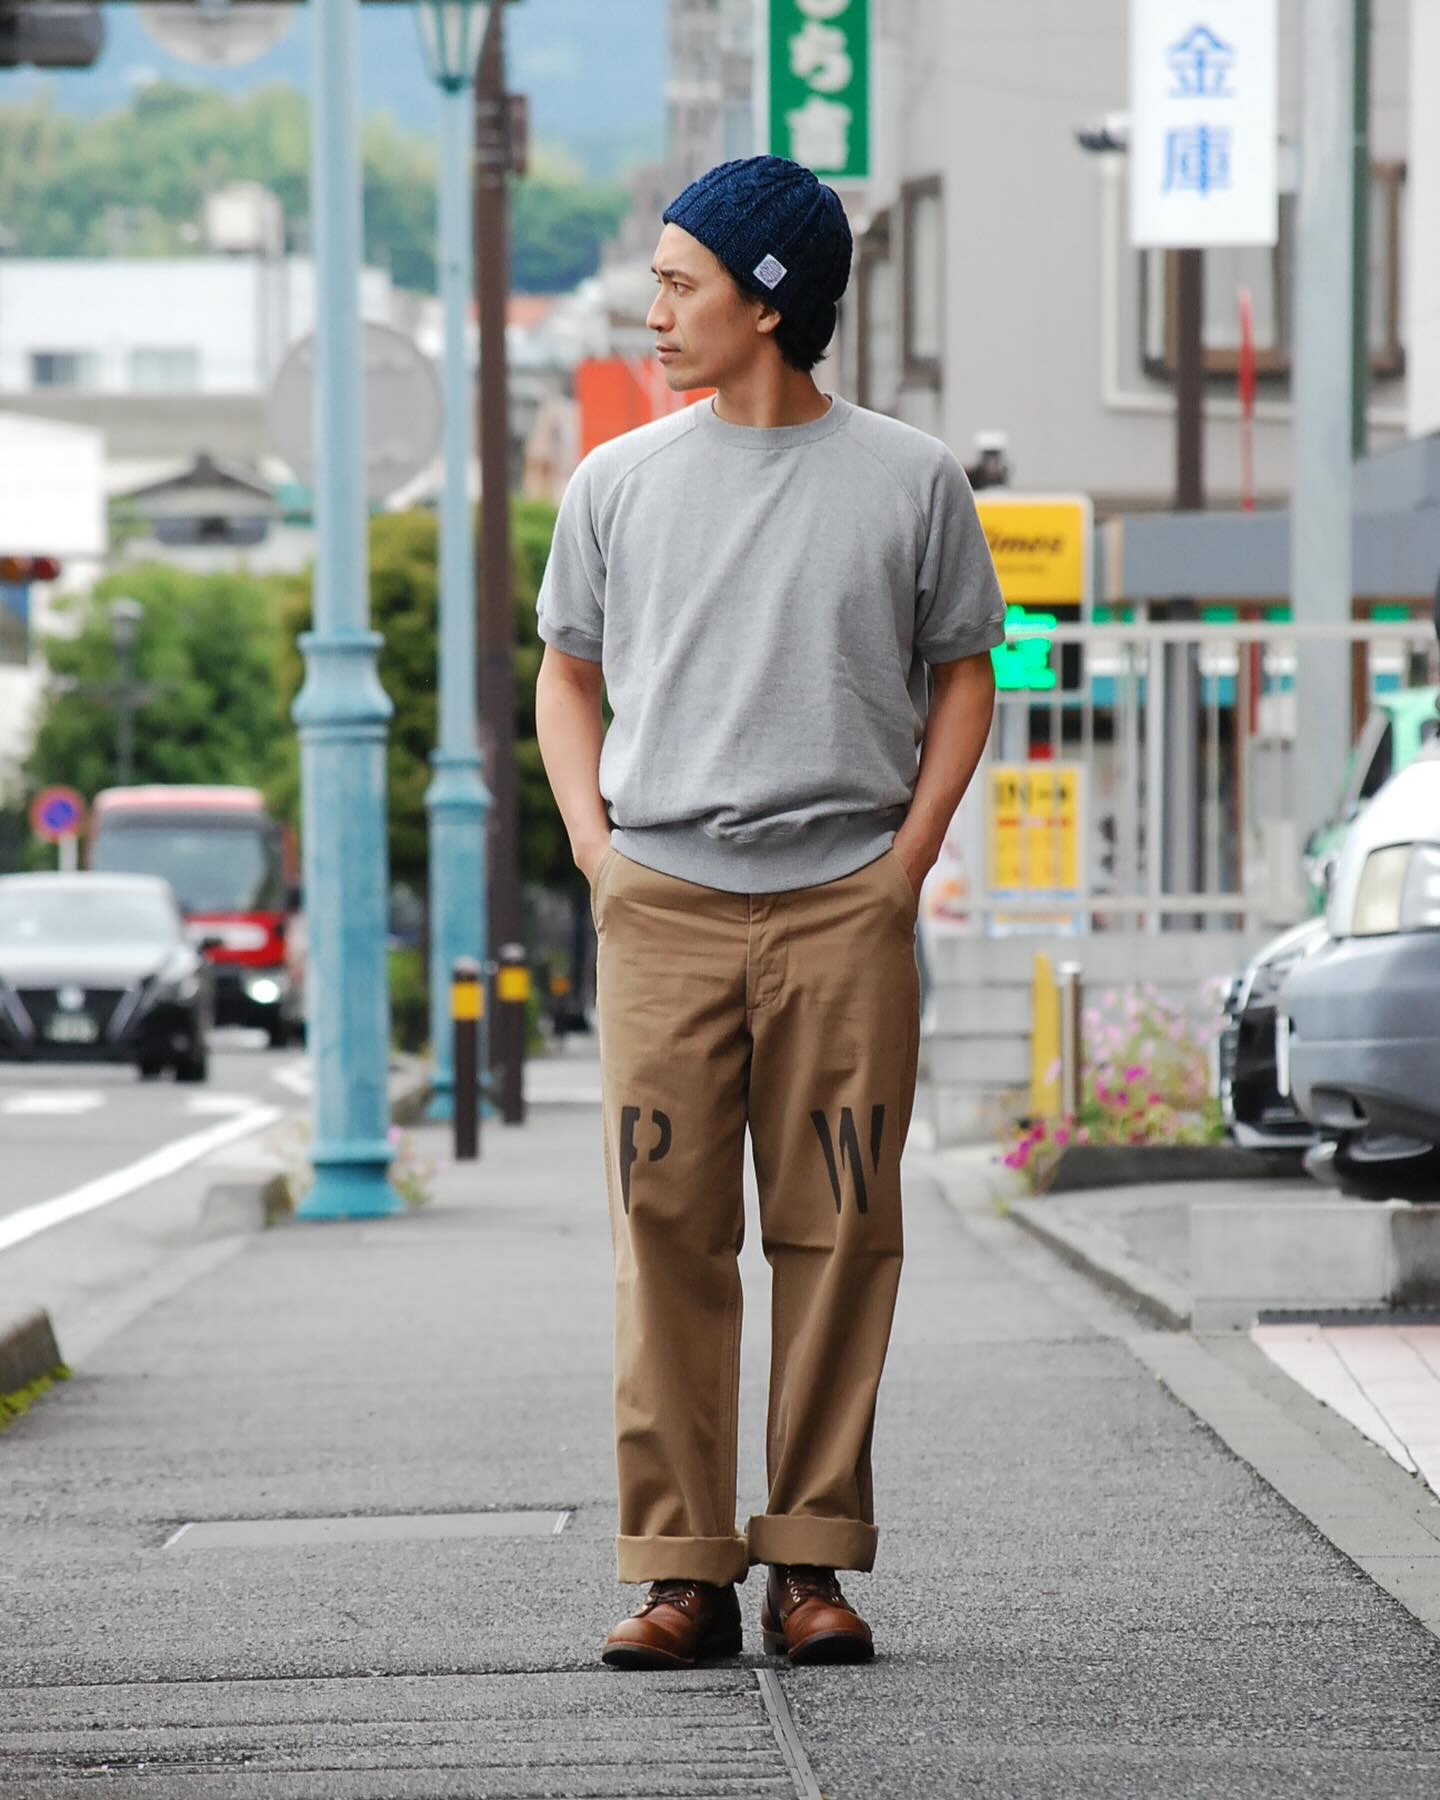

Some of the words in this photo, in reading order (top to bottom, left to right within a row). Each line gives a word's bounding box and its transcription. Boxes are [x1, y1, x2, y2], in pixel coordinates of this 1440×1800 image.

[1162, 22, 1235, 198] 金庫
[620, 1106, 672, 1215] P
[810, 1104, 885, 1215] W
